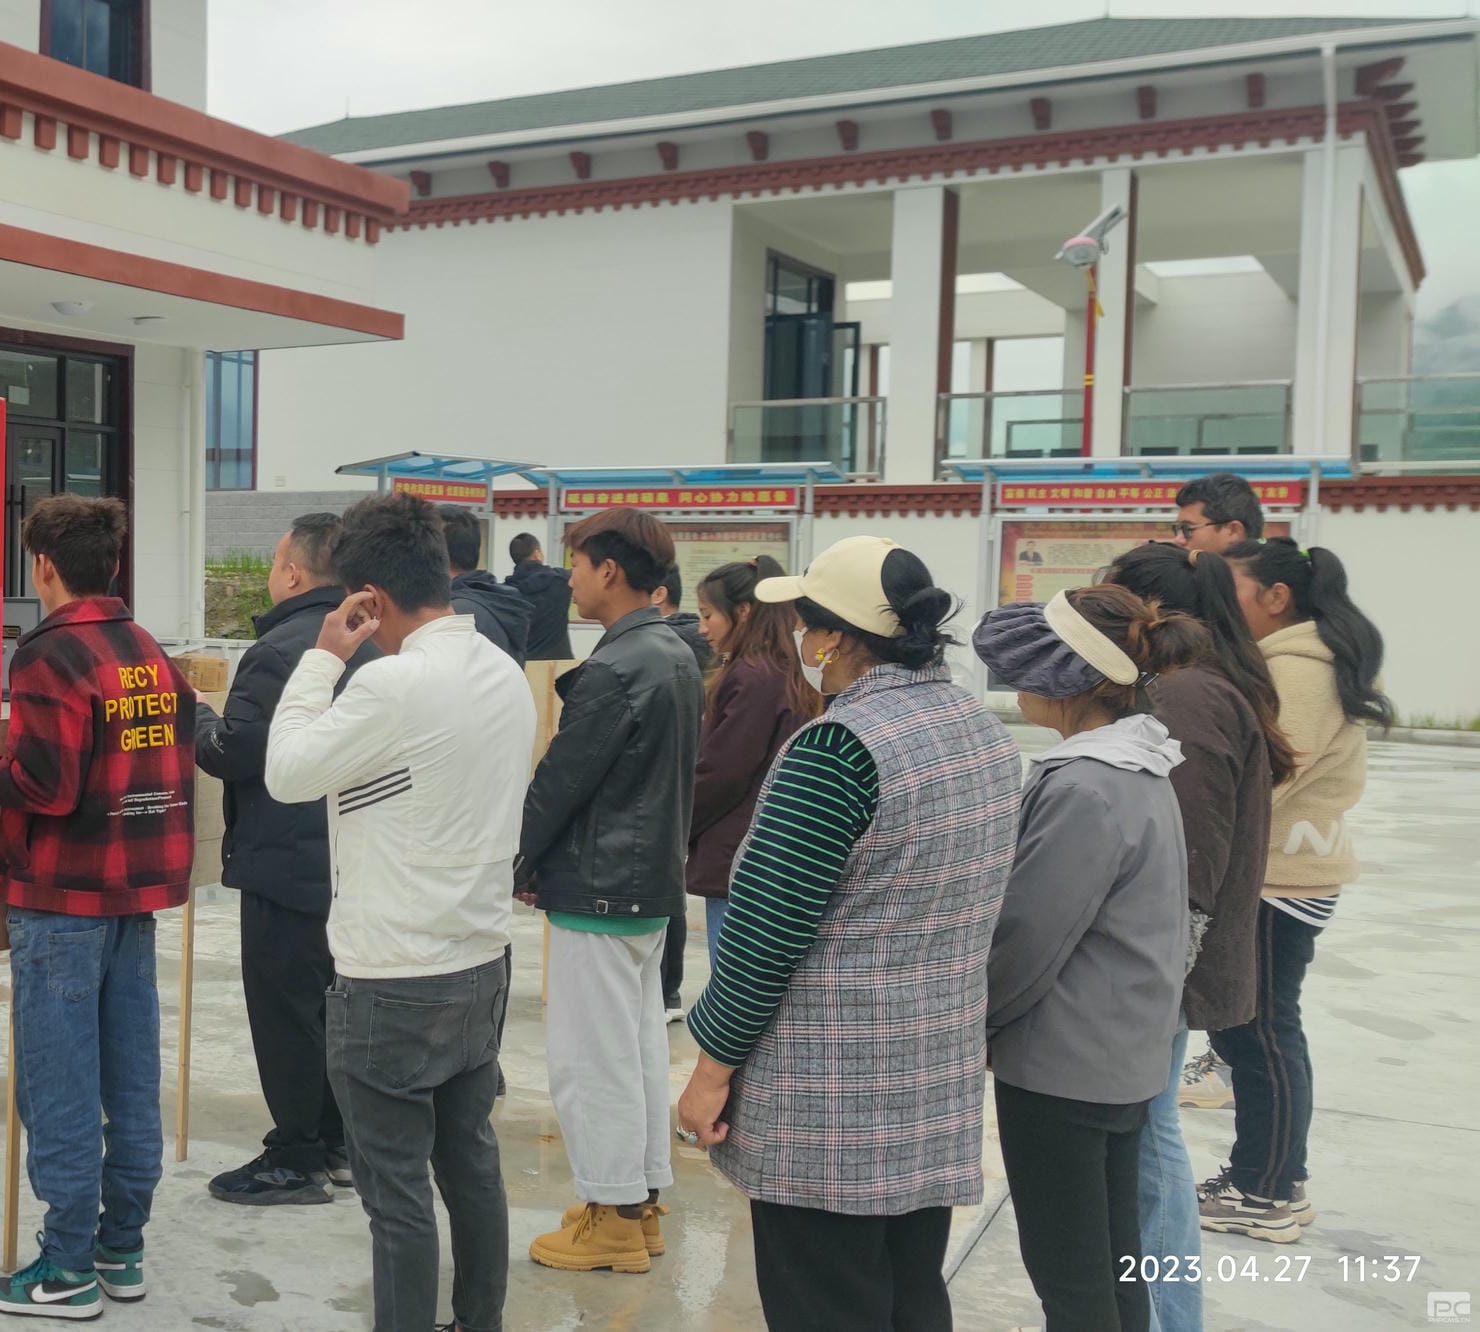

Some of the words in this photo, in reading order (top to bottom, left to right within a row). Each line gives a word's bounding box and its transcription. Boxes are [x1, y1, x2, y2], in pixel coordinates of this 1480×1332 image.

[120, 664, 159, 690] RECY
[105, 692, 178, 723] PROTECT
[120, 723, 175, 752] GREEN
